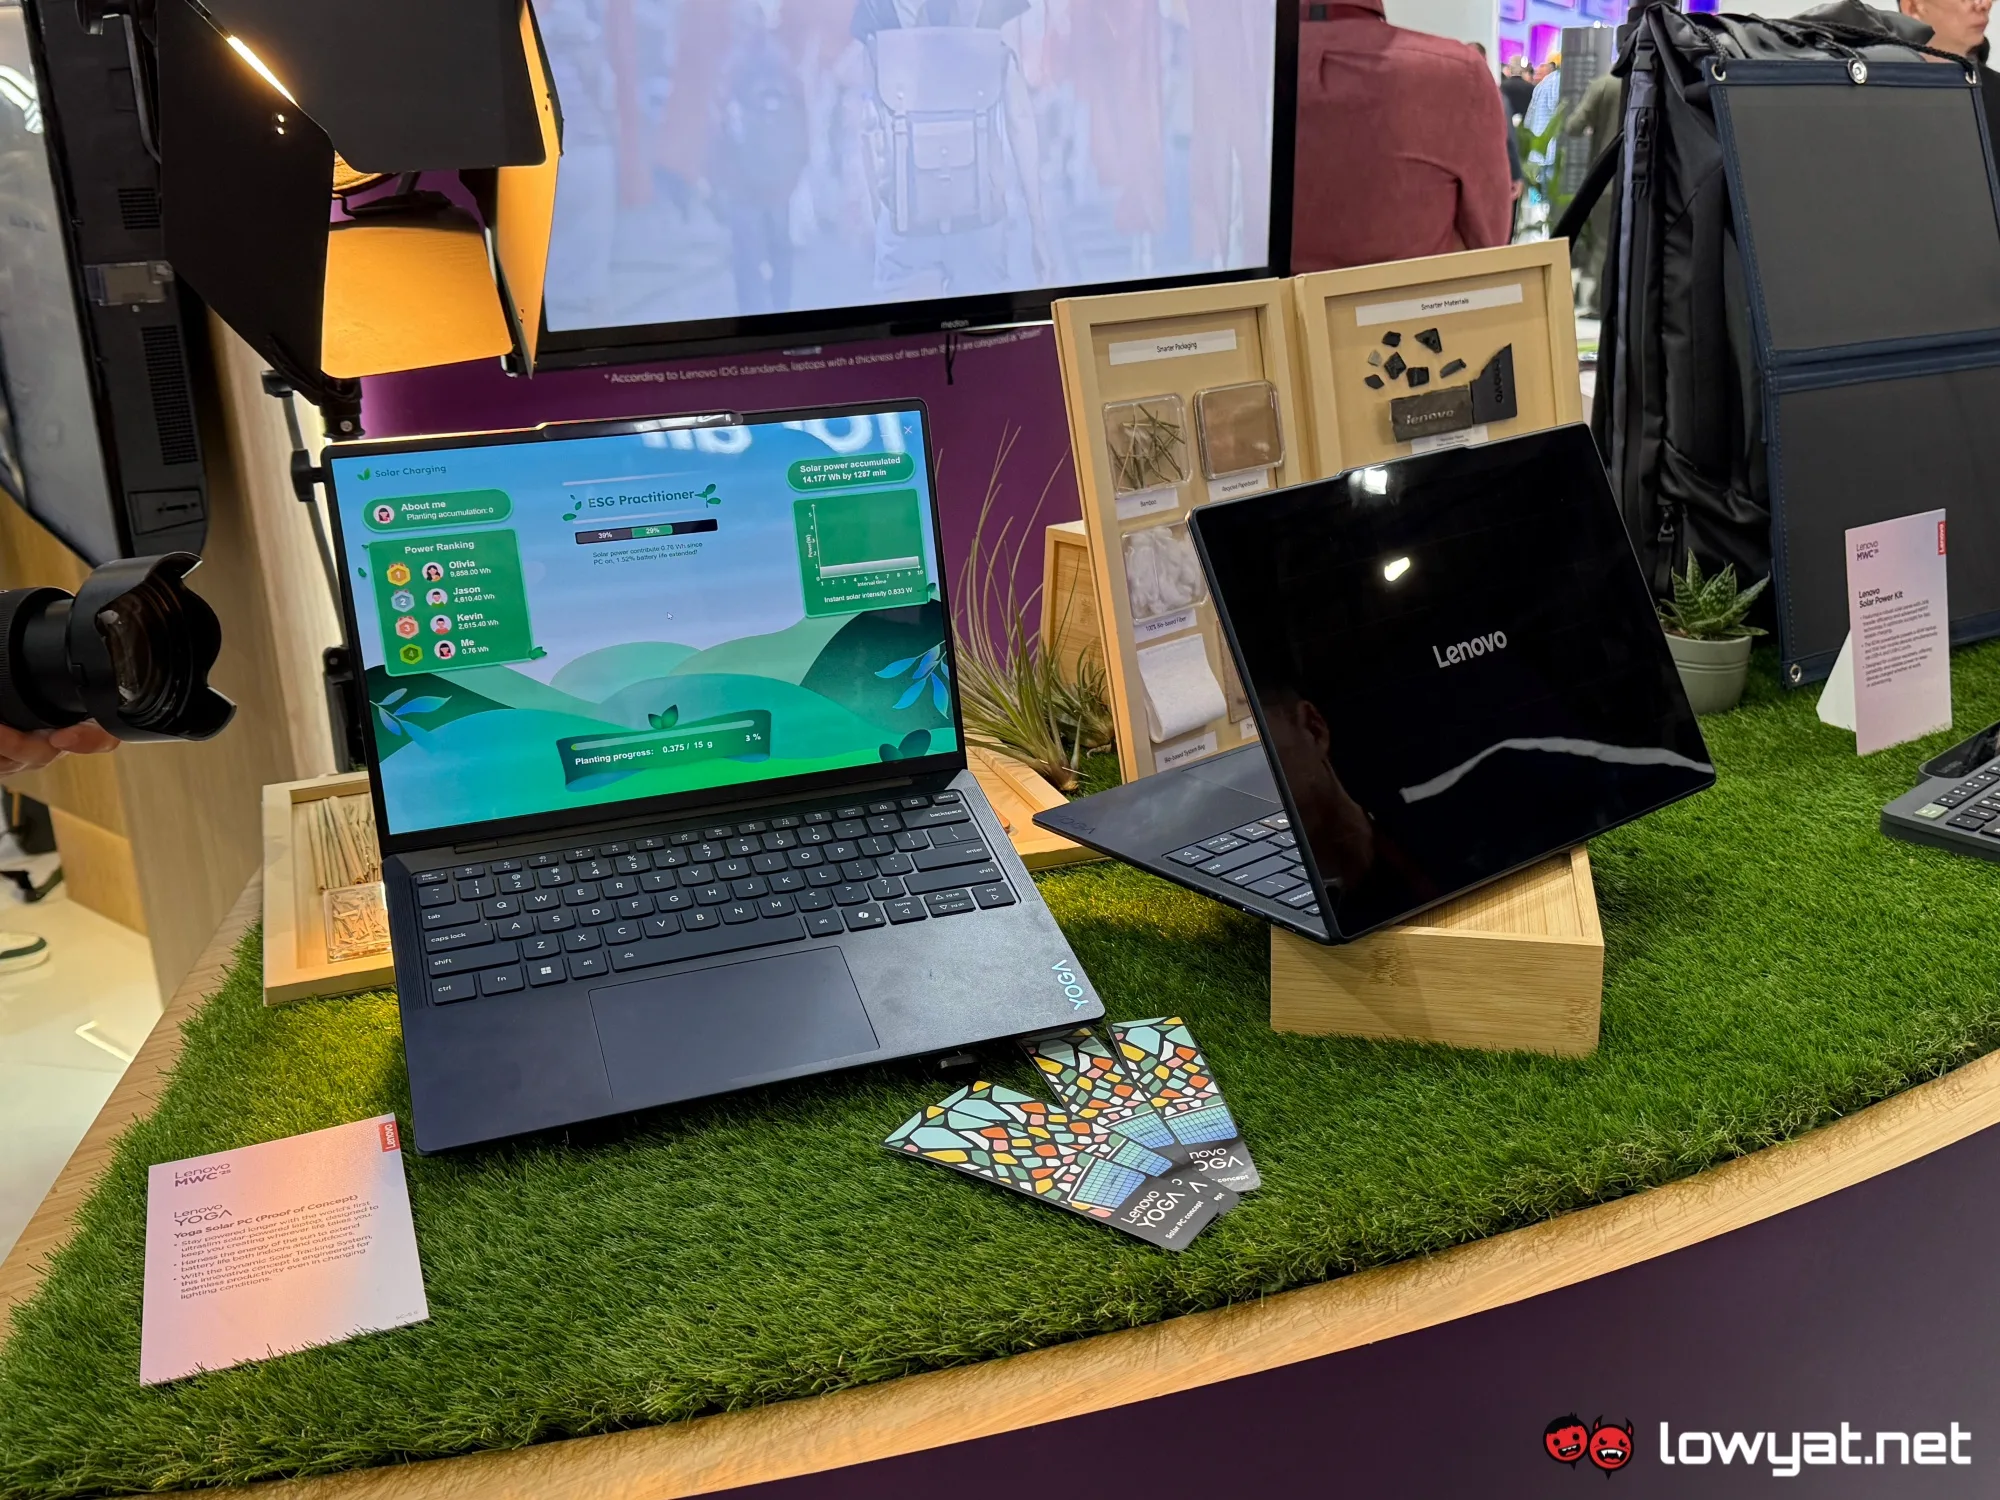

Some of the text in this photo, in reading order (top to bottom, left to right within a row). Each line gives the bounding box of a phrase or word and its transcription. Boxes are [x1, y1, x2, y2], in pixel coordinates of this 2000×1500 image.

[1421, 298, 1469, 311] Smarter Materials
[1157, 342, 1198, 353] Smarter Packaging
[610, 357, 847, 383] According to Lenovo IDG standards, laptops with
[375, 465, 447, 478] Solar Charging
[800, 456, 901, 473] Solar power accumulated
[802, 474, 827, 484] 14.177
[842, 473, 852, 481] by
[853, 470, 870, 478] 1287
[872, 469, 887, 477] min
[401, 501, 446, 511] About me
[588, 490, 695, 508] ESG Practitioner
[406, 512, 437, 521] Planting
[438, 508, 488, 518] accumulation:
[598, 531, 612, 539] 39%
[404, 541, 475, 554] Power Ranking
[610, 549, 629, 558] power
[630, 546, 660, 555] contribute
[1856, 540, 1878, 552] Lenovo
[1857, 549, 1874, 561] MWC
[448, 560, 475, 569] Olivia
[453, 586, 481, 596] Jason
[824, 594, 845, 604] Instant
[846, 593, 861, 601] solar
[861, 590, 887, 600] intensity
[1858, 587, 1880, 599] Lenovo
[1859, 590, 1903, 608] Solar Power Kit
[456, 612, 483, 621] Kevin
[458, 619, 499, 630] 2,615.40 Wh
[460, 639, 475, 647] Me
[1432, 630, 1508, 668] Lenovo
[462, 647, 477, 655] 0.76
[575, 733, 761, 766] Planting progress: 0.375 15 g 3 %
[430, 935, 449, 943] caps
[434, 958, 452, 966] shift
[1051, 959, 1089, 1010] YOGA
[385, 1123, 396, 1149] Lenovo
[1189, 1148, 1226, 1160] novo
[174, 1163, 231, 1179] Lenovo
[1193, 1156, 1244, 1172] OGA
[174, 1172, 218, 1187] MWC
[1217, 1174, 1249, 1183] concept
[174, 1204, 223, 1218] Lenovo
[1120, 1190, 1161, 1224] Lenovo
[1136, 1191, 1186, 1228] YOGA
[174, 1230, 202, 1238] Yoga
[206, 1222, 235, 1232] Solar
[255, 1209, 291, 1222] (Proof
[307, 1195, 358, 1210] Concept)
[174, 1209, 232, 1226] YOGA
[1165, 1200, 1204, 1240] Solar PC concept
[181, 1241, 221, 1252] ultraslim
[223, 1225, 289, 1243] solar-powered
[326, 1207, 367, 1221] designed
[205, 1228, 246, 1242] powered
[248, 1223, 277, 1232] longer
[279, 1217, 299, 1225] with
[181, 1250, 204, 1258] keep
[226, 1237, 265, 1248] creating
[267, 1228, 308, 1239] wherever
[327, 1218, 351, 1226] takes
[181, 1255, 218, 1266] Harness
[237, 1244, 269, 1254] energy
[329, 1222, 360, 1234] extend
[181, 1262, 214, 1272] battery
[232, 1253, 254, 1261] both
[257, 1246, 291, 1256] indoors
[293, 1240, 310, 1248] and
[312, 1231, 354, 1244] outdoors.
[181, 1272, 204, 1280] With
[225, 1259, 266, 1271] Dynamic
[269, 1253, 293, 1261] Solar
[296, 1244, 334, 1255] Tracking
[337, 1235, 372, 1246] System,
[181, 1280, 224, 1292] seamless
[227, 1268, 284, 1284] productivity
[287, 1262, 309, 1270] even
[322, 1249, 366, 1262] changing
[201, 1269, 249, 1282] innovative
[251, 1259, 290, 1272] concept
[302, 1244, 354, 1260] engineered
[181, 1278, 271, 1299] lighting conditions.
